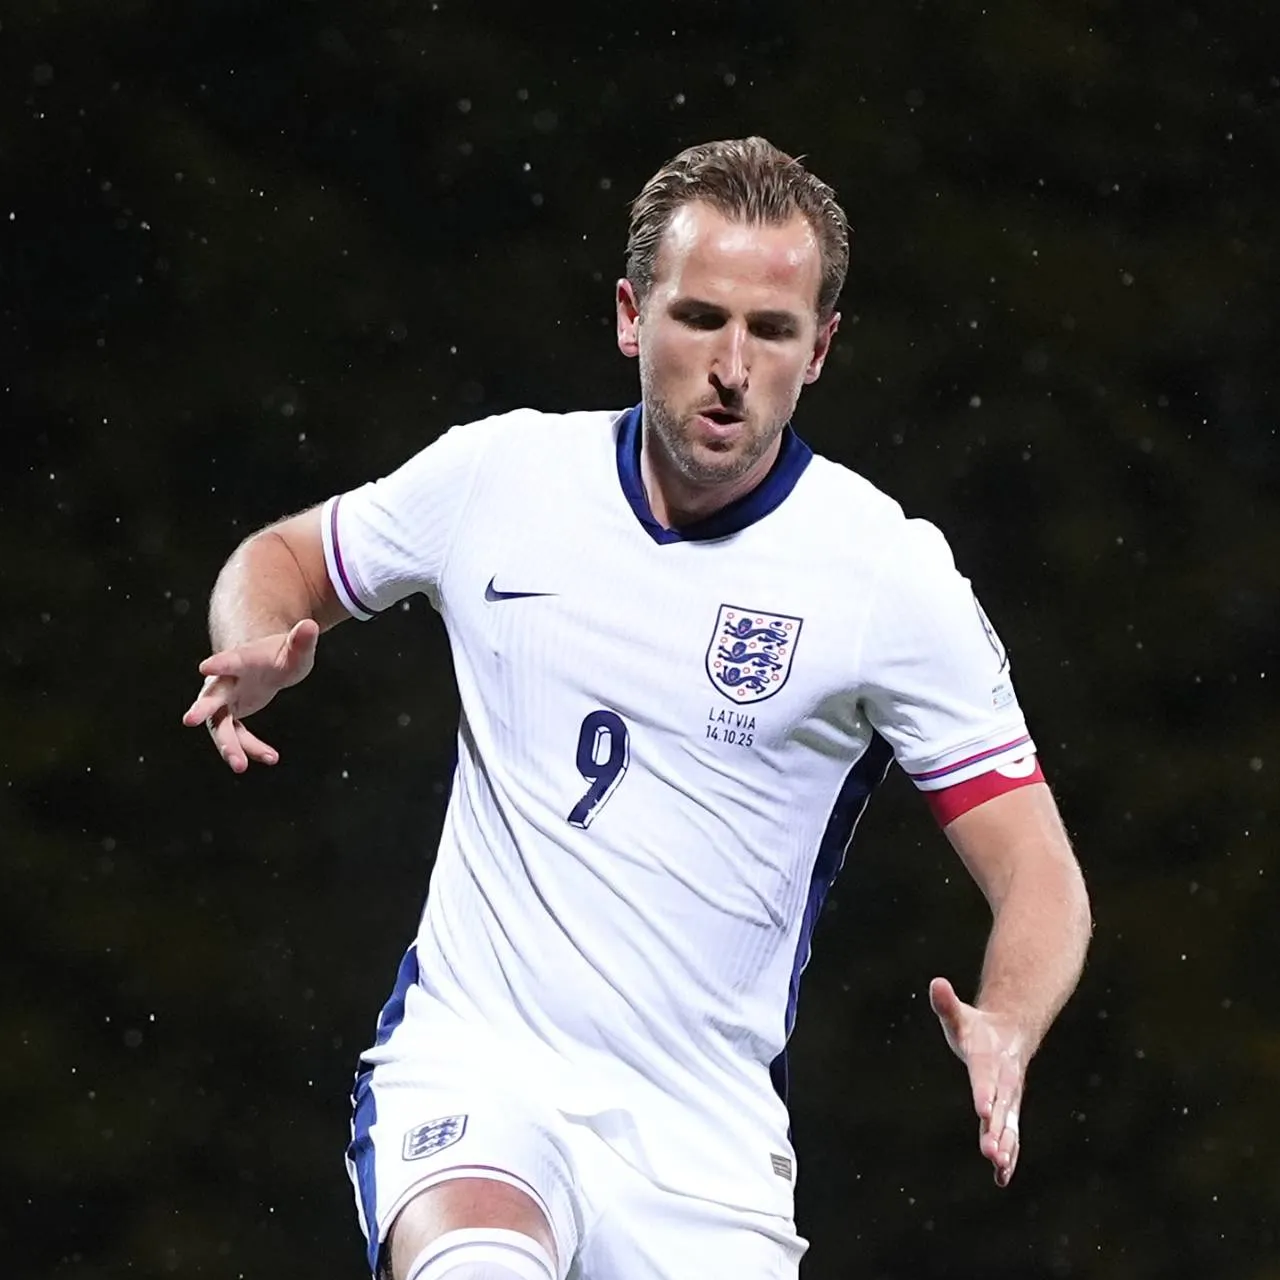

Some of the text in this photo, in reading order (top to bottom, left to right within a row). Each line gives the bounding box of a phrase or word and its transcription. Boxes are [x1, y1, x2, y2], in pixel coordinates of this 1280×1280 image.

[708, 706, 756, 730] LATVIA
[705, 725, 754, 747] 14.10.25
[567, 709, 631, 830] 9
